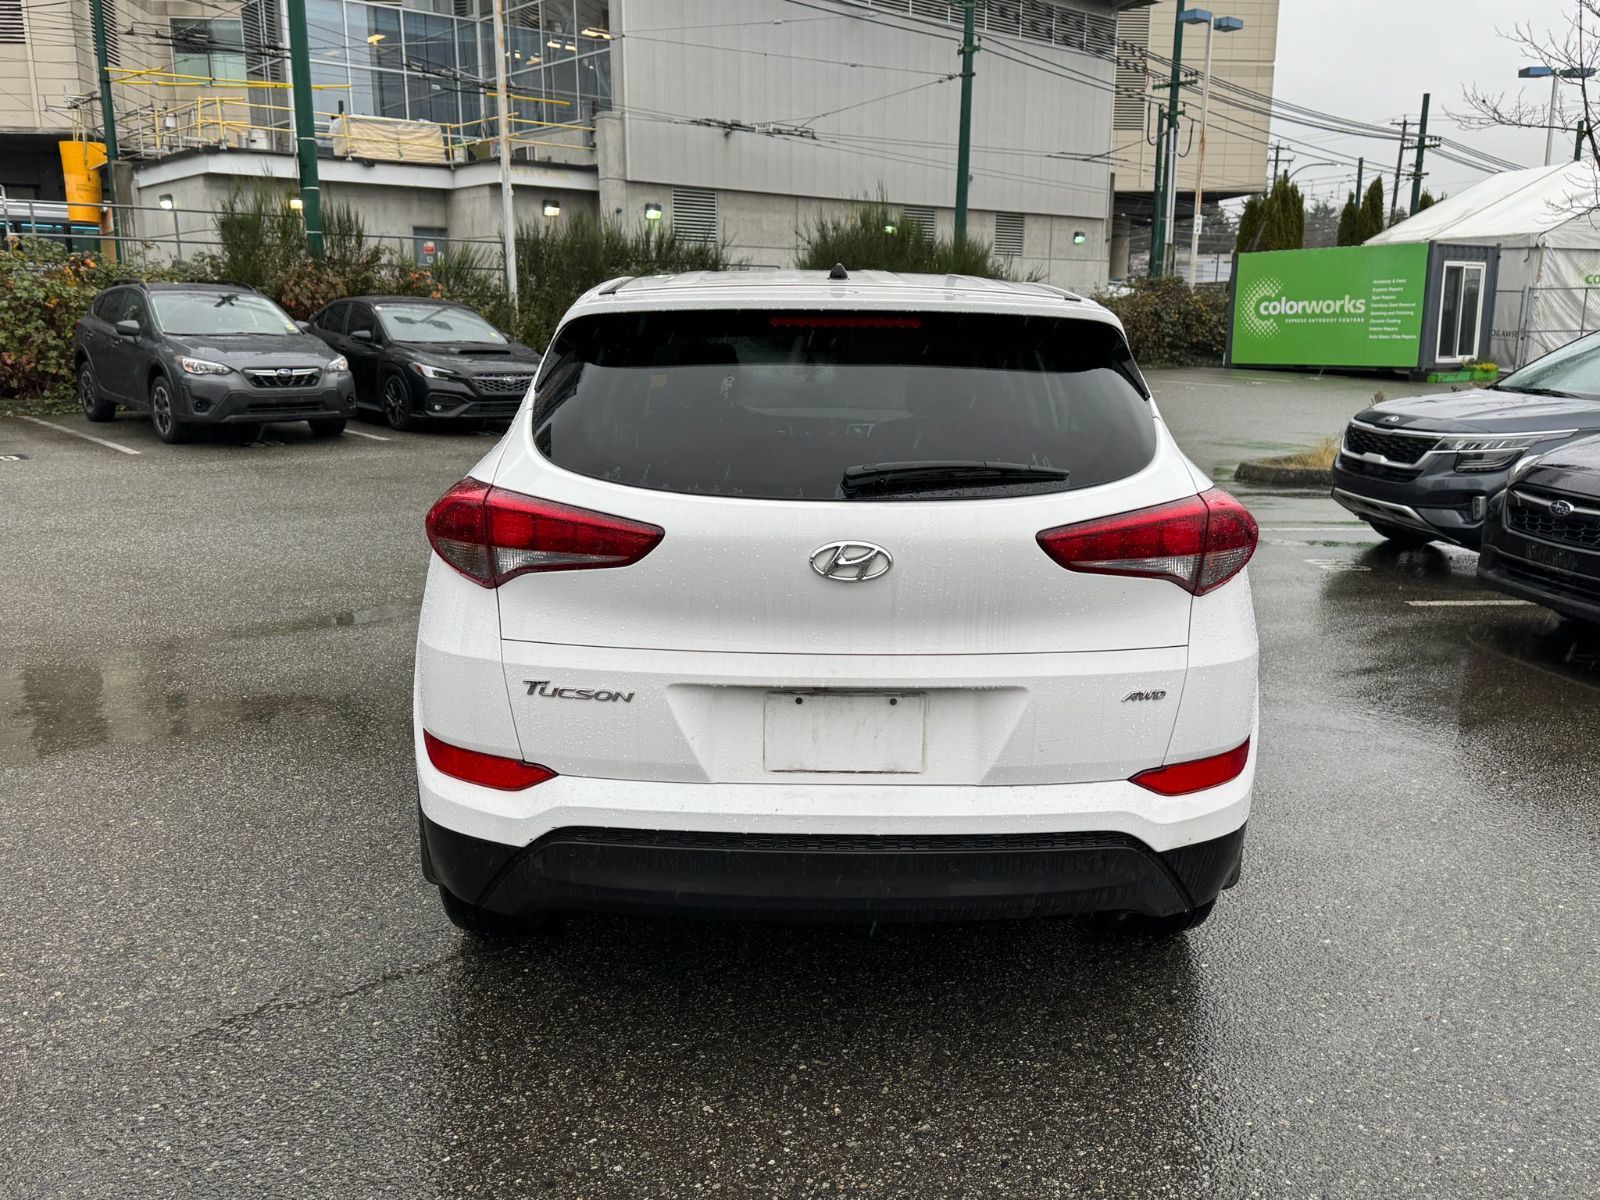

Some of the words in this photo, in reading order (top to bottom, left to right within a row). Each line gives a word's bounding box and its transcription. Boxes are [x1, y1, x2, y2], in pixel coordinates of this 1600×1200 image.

[1259, 294, 1366, 315] colorworks
[522, 679, 635, 703] TUCSON
[1120, 690, 1167, 702] AWD
